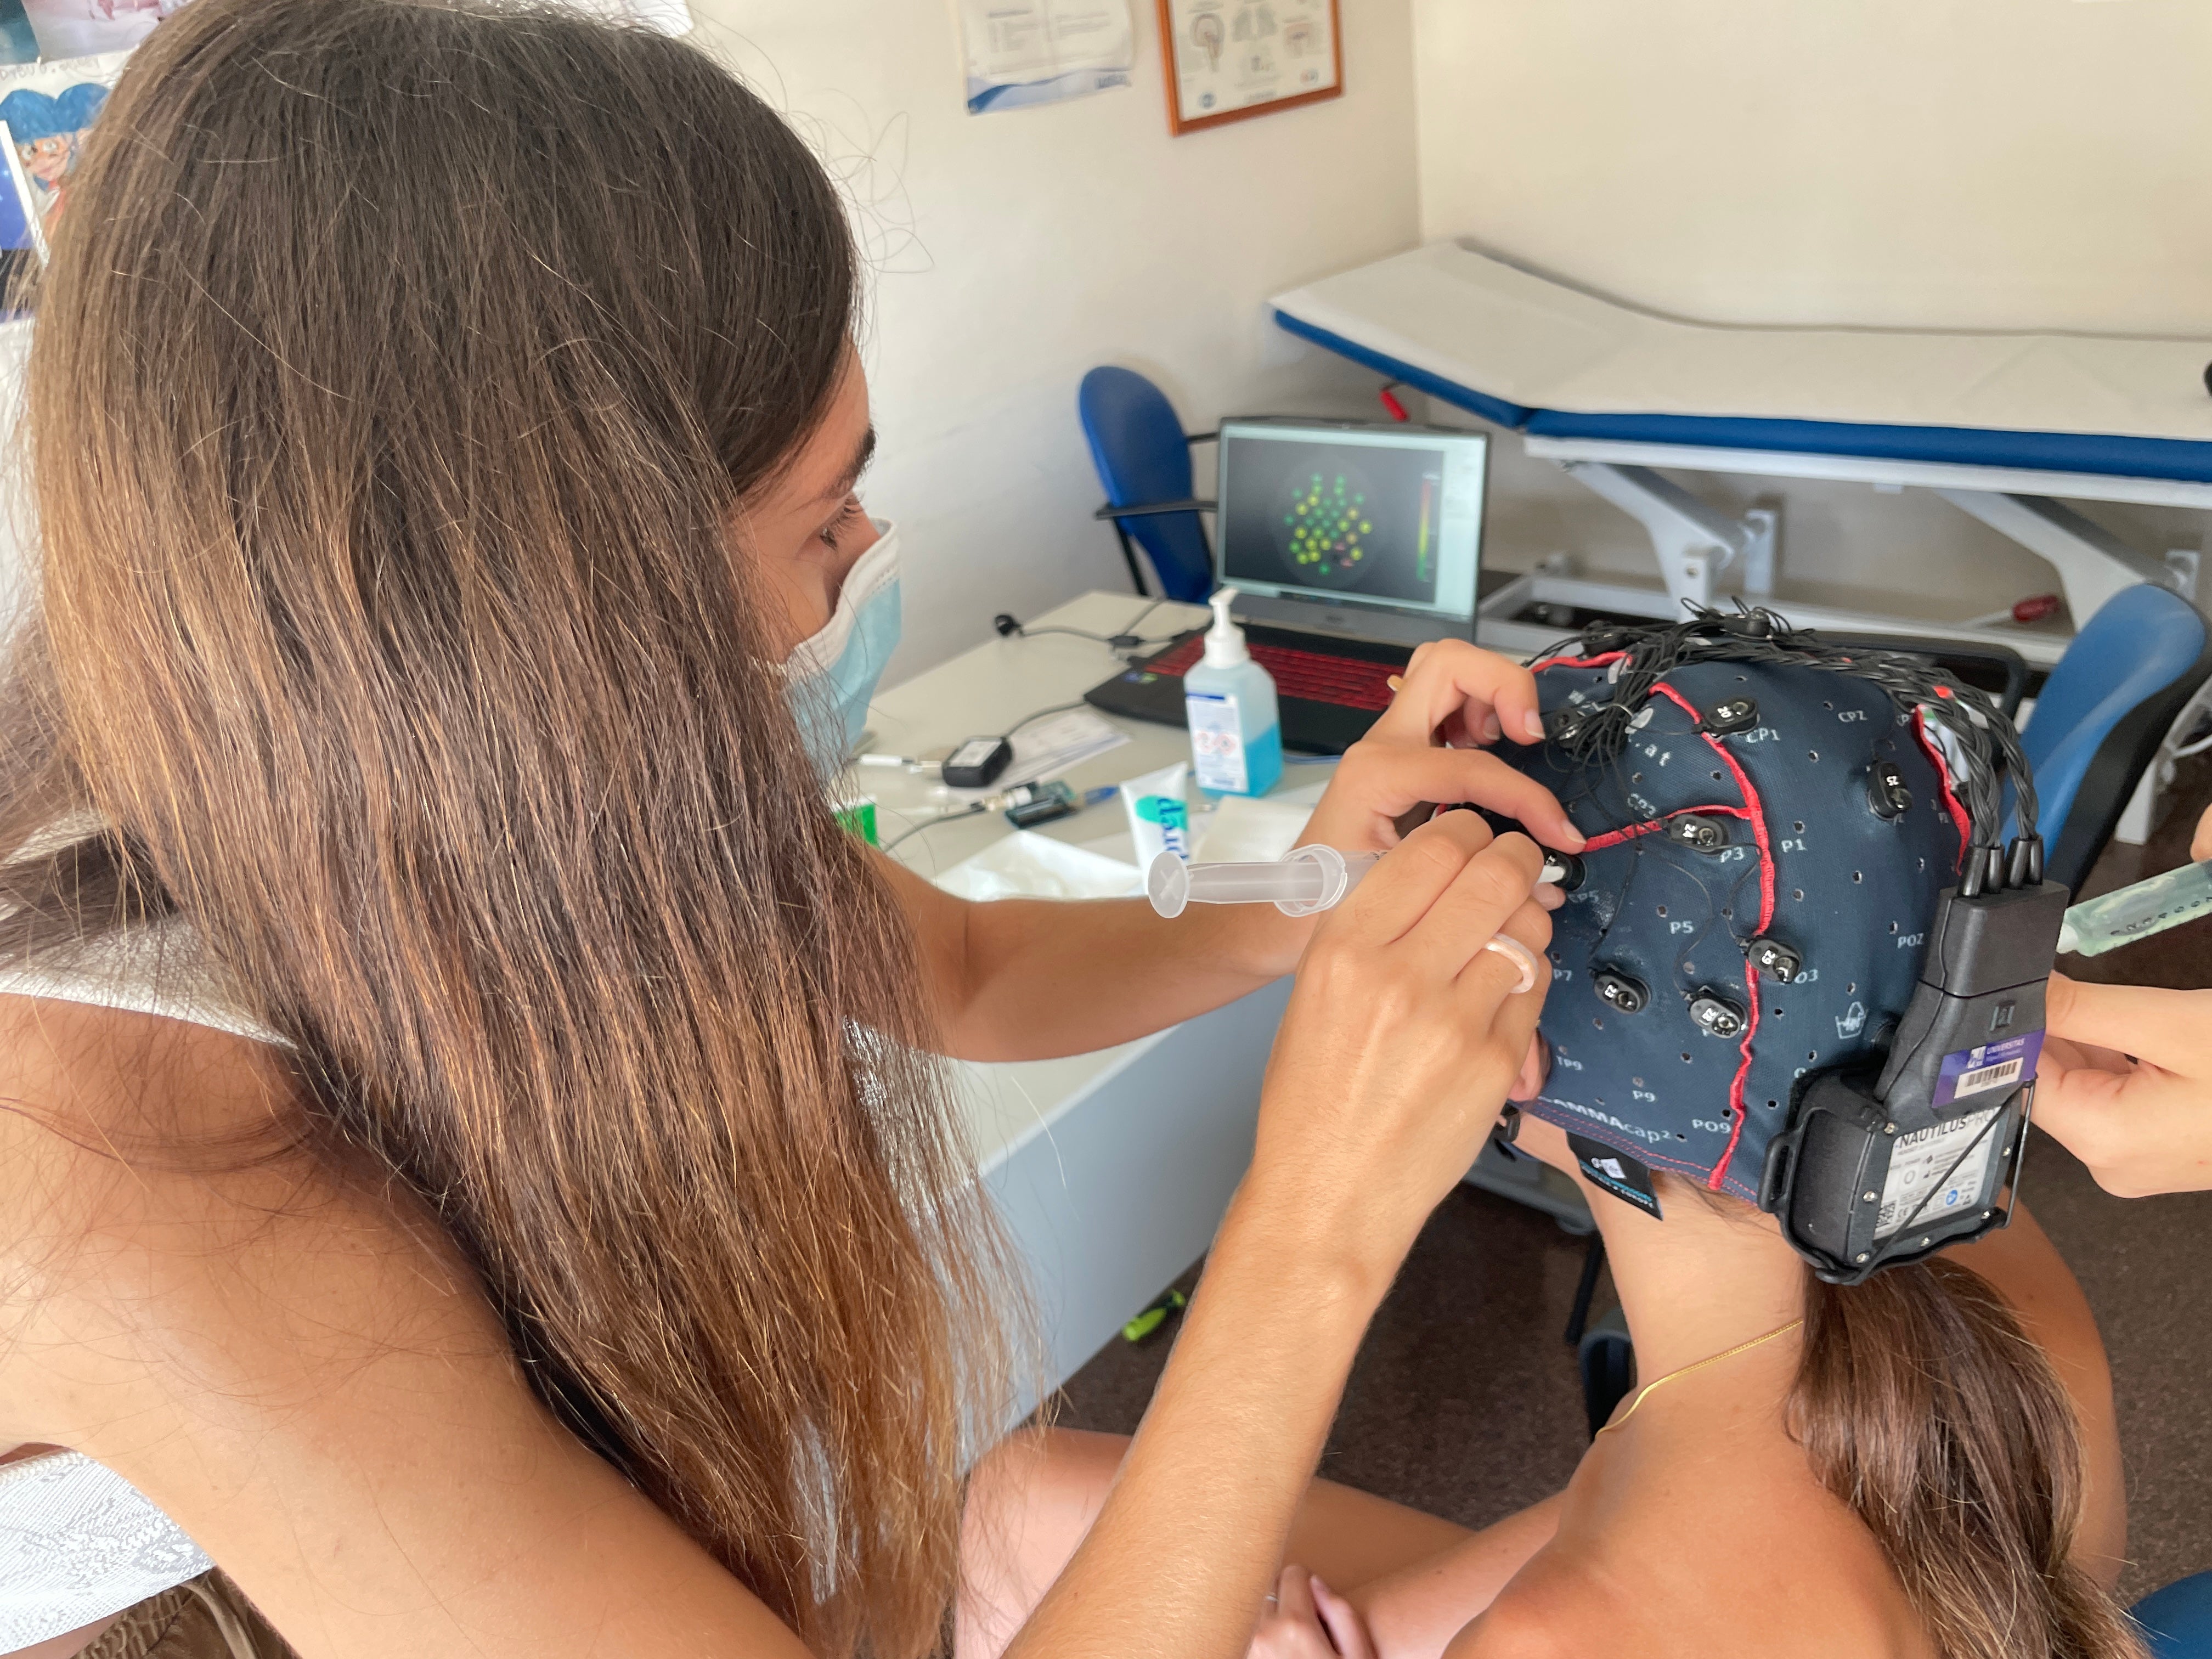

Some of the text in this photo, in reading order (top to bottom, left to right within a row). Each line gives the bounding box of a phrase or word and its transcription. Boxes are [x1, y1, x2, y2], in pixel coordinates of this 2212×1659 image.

[1717, 706, 1732, 719] 20
[1746, 726, 1781, 744] CP1
[1683, 823, 1698, 839] 24
[1781, 838, 1808, 854] P1
[1719, 846, 1745, 864] P3
[1669, 920, 1695, 935] P5
[1761, 949, 1777, 965] 29
[1795, 969, 1819, 984] O3
[1604, 984, 1618, 998] 23
[1701, 1007, 1718, 1022] 28
[1632, 1090, 1657, 1103] P9
[1692, 1118, 1733, 1134] PO9
